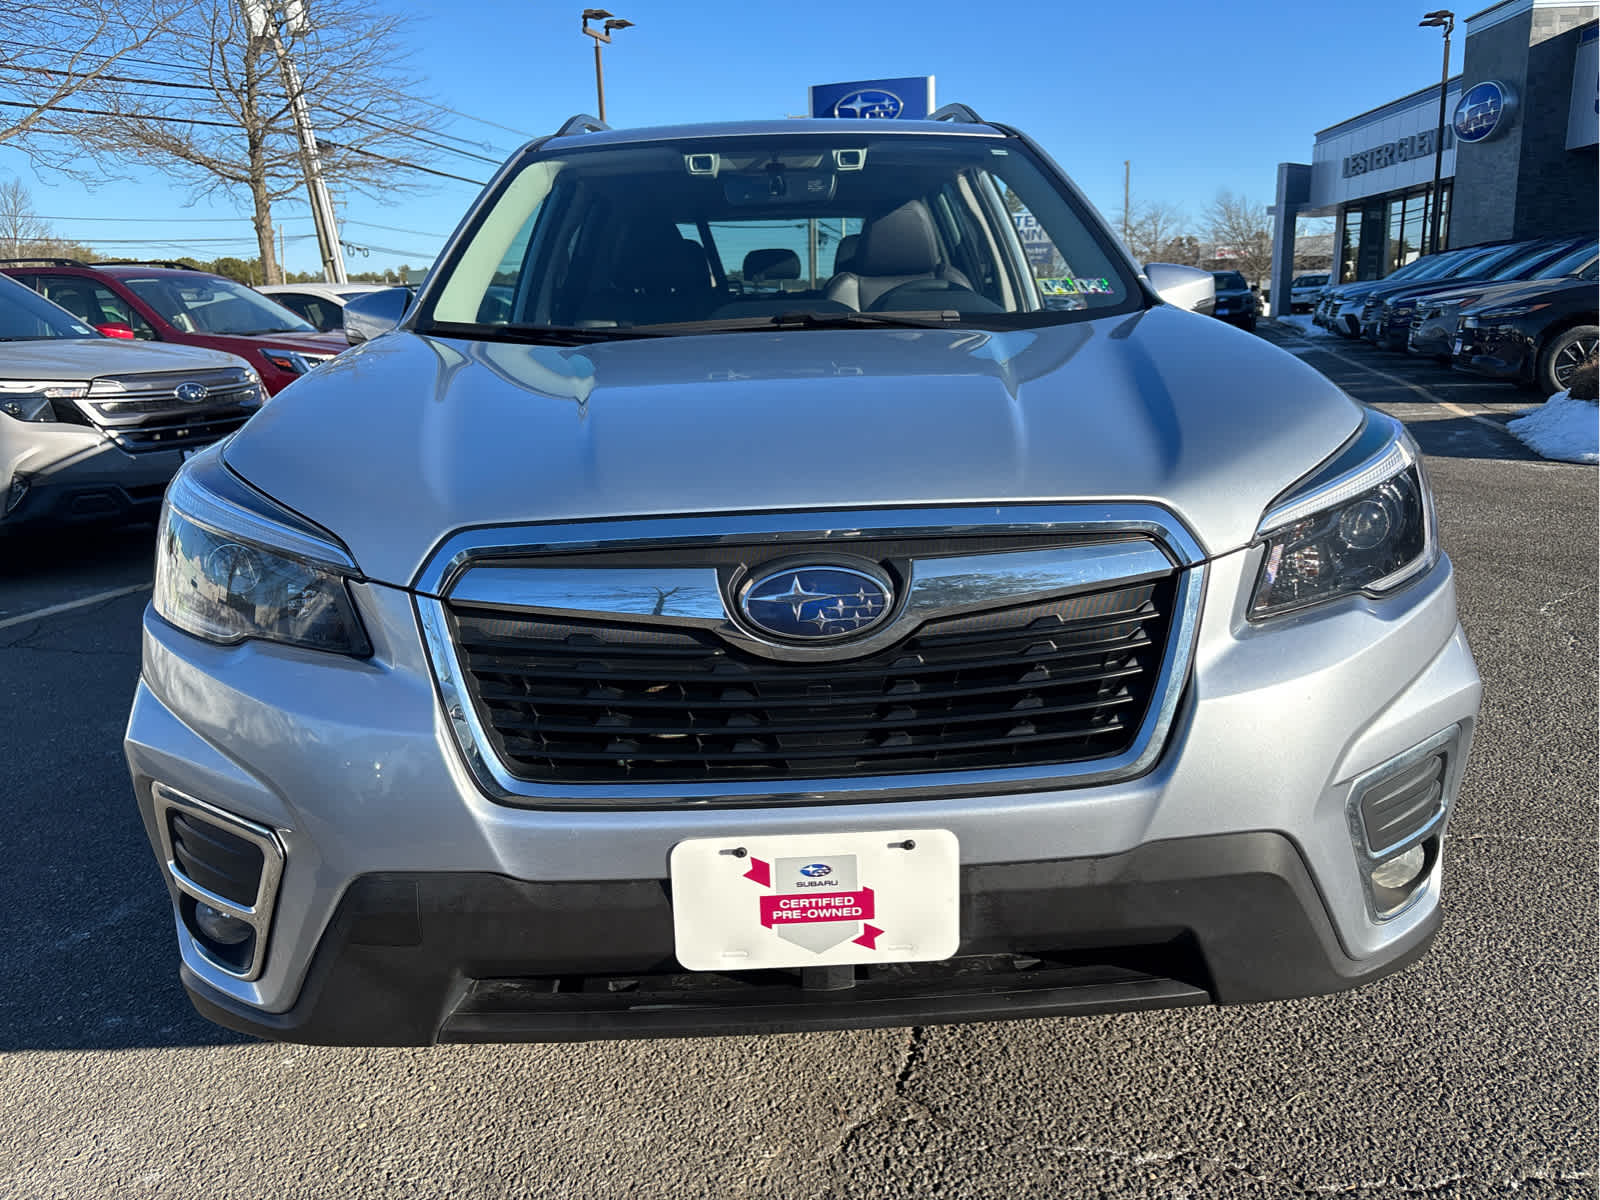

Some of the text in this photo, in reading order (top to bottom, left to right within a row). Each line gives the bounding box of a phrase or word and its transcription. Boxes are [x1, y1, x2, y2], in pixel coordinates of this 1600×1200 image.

[1343, 143, 1396, 178] LESTER
[796, 880, 838, 888] SUBARU
[779, 897, 854, 908] CERTIFIED
[772, 907, 862, 919] PRE-OWNED
